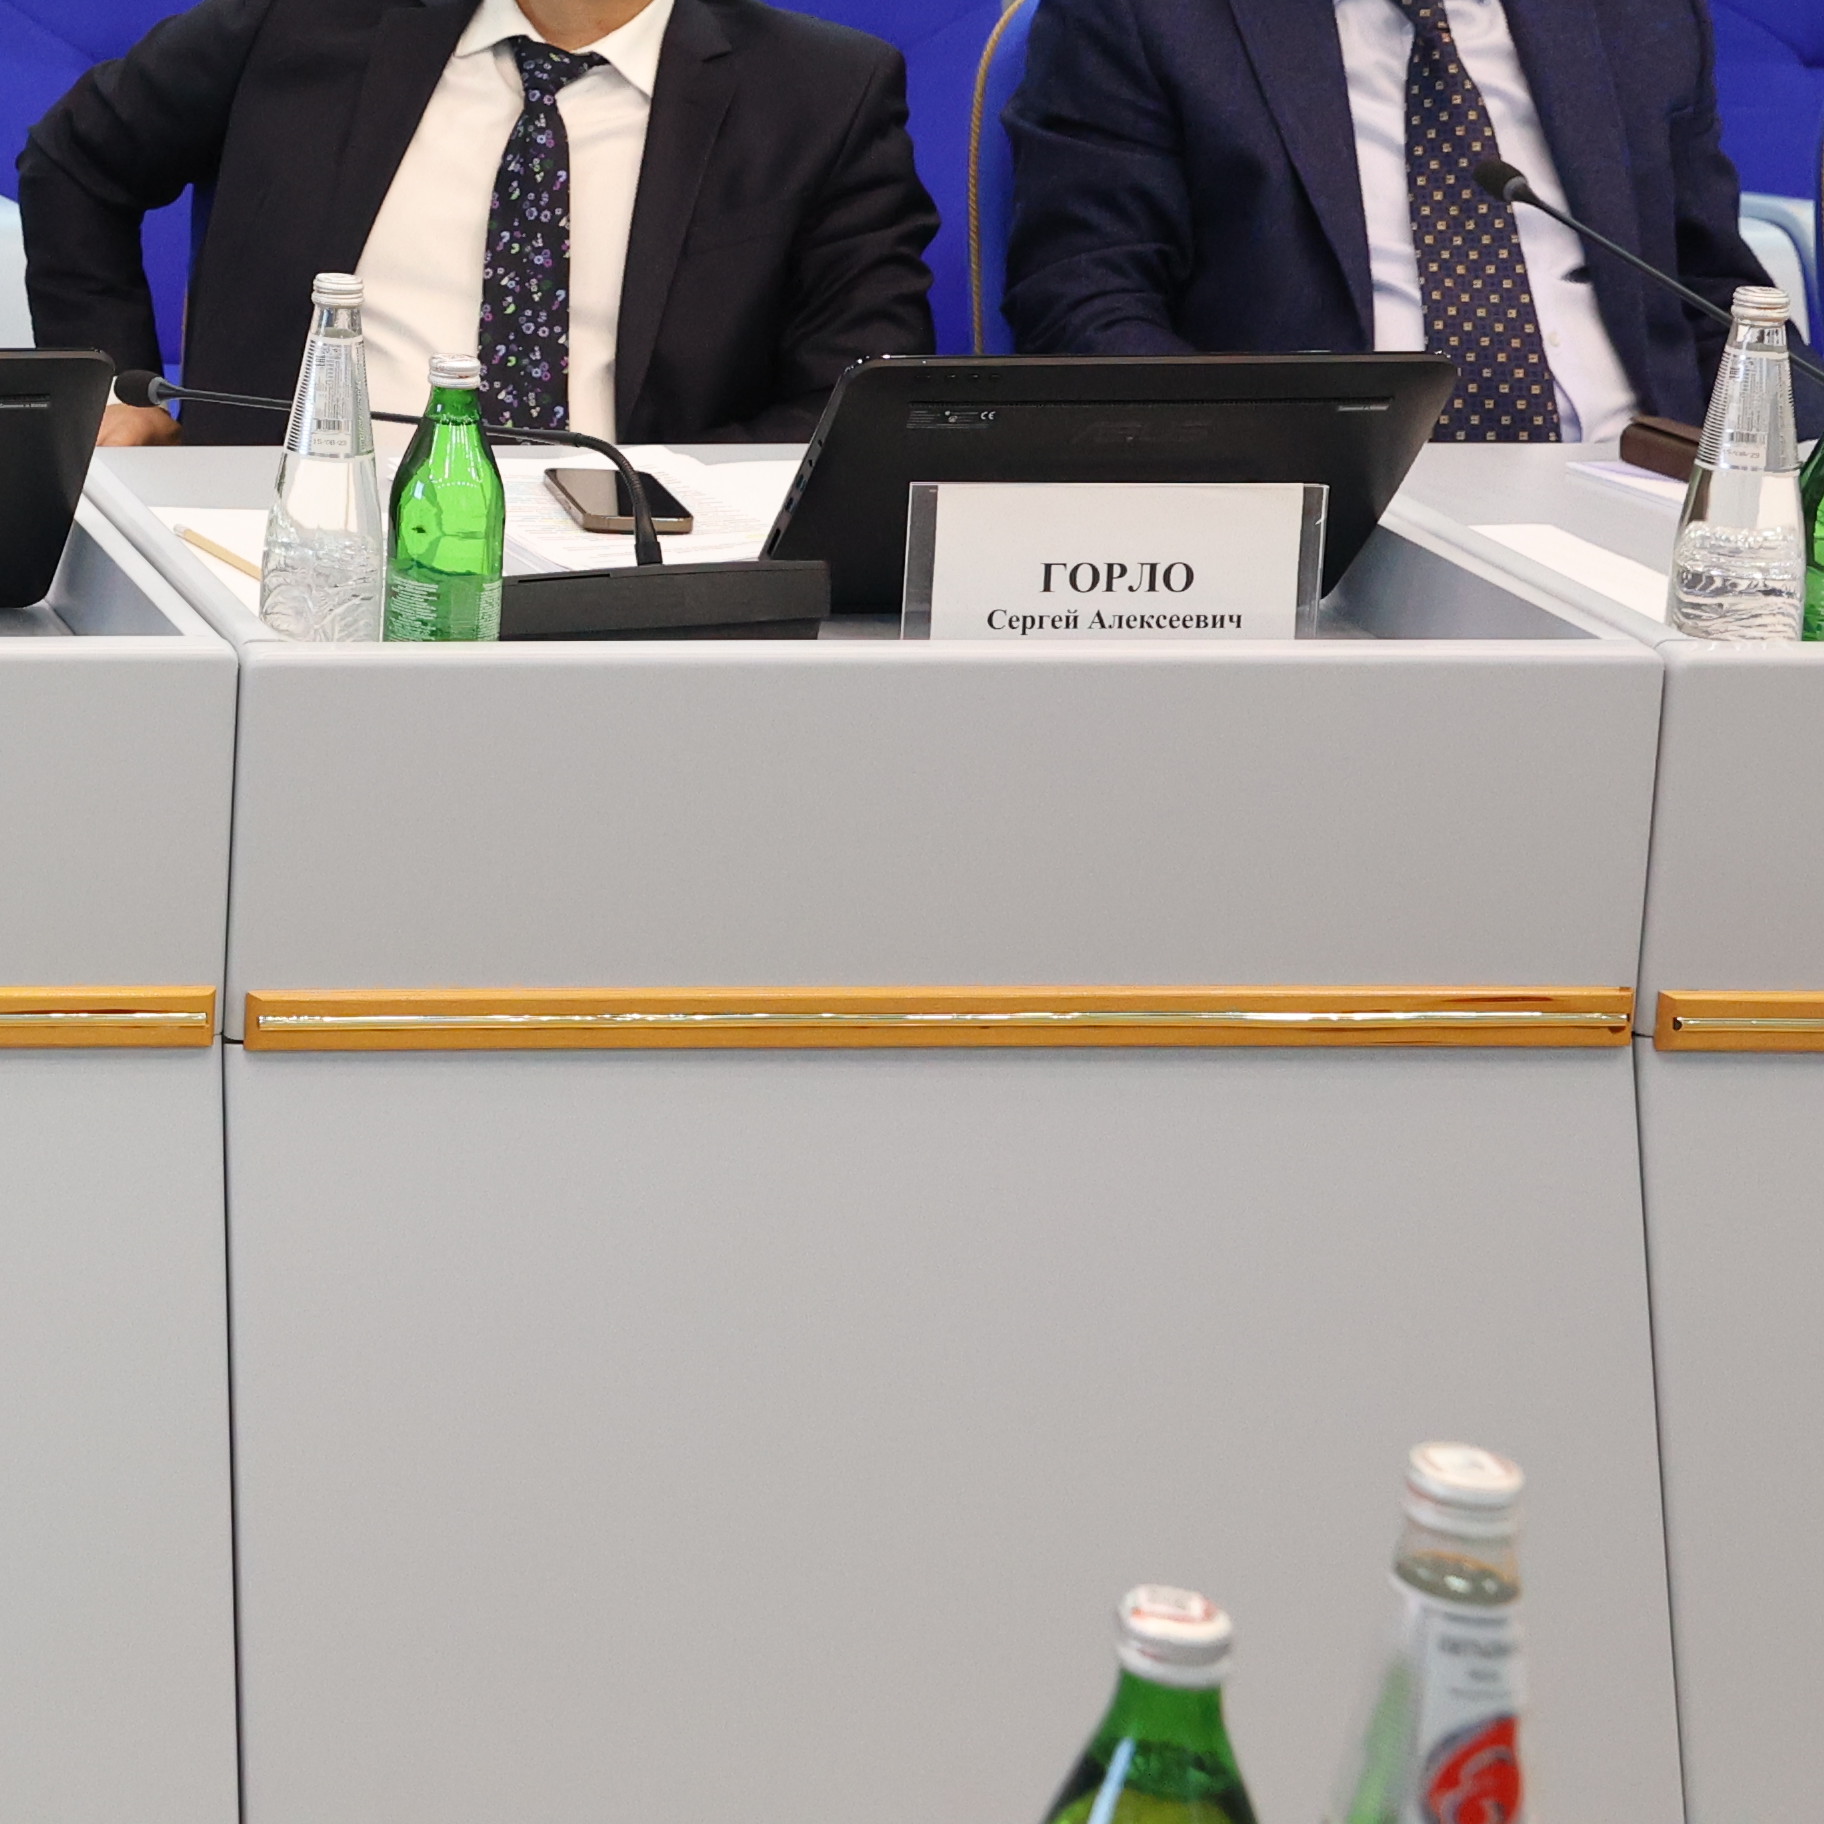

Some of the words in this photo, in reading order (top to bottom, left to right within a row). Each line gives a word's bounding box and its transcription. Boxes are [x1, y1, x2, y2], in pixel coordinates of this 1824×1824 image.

[1039, 561, 1195, 594] ГОРЛО
[986, 608, 1080, 636] Сергей
[1087, 608, 1243, 630] Алексеевич
